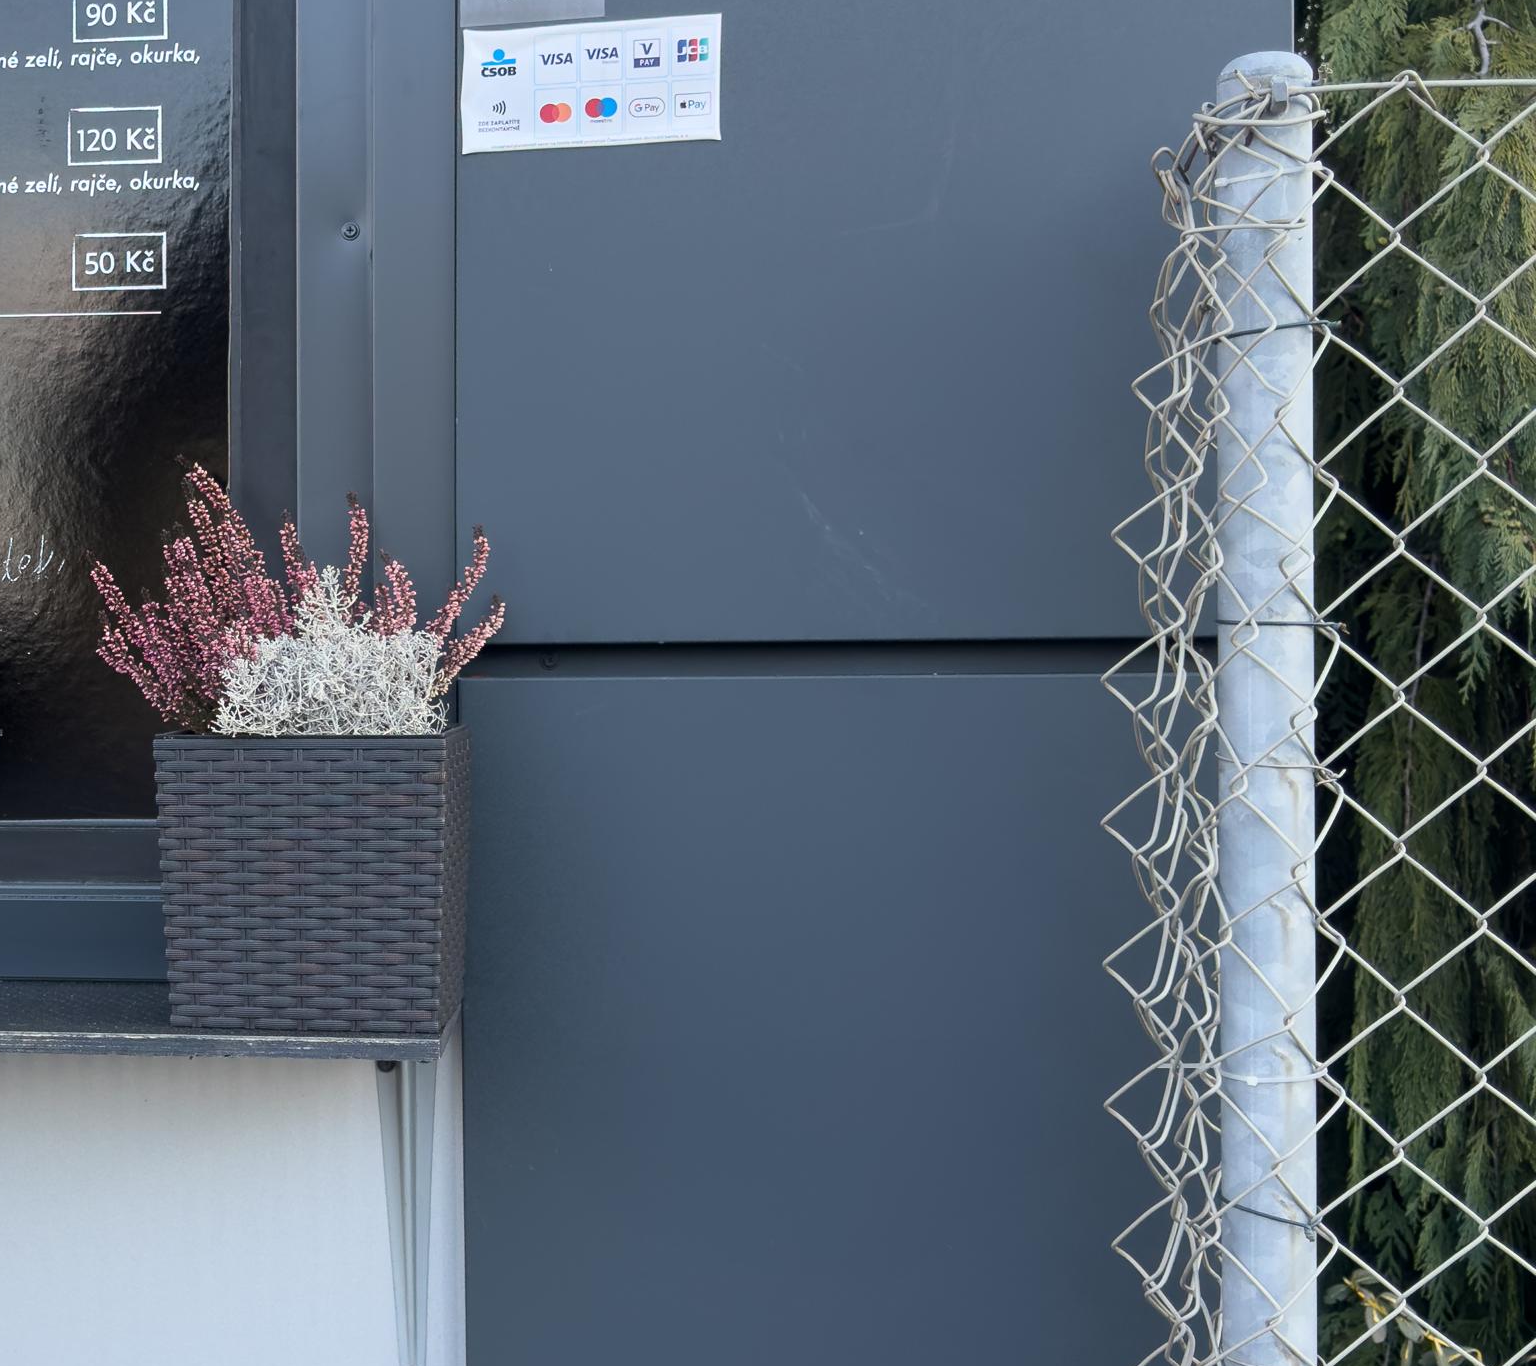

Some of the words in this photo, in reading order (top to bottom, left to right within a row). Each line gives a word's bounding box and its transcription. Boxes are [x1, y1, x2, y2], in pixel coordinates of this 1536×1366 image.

[86, 3, 116, 26] 90
[128, 1, 155, 23] Kč
[25, 48, 62, 69] zelí,
[71, 47, 121, 71] rajče,
[131, 44, 200, 65] okurka,
[538, 53, 573, 65] VISA
[584, 47, 619, 60] VISA
[639, 58, 655, 67] PAY
[645, 103, 660, 113] Pay
[688, 99, 707, 109] Pay
[77, 129, 116, 151] 120
[127, 128, 154, 150] Kč
[25, 174, 62, 195] zelí,
[71, 173, 121, 197] rajče,
[130, 171, 199, 191] okurka,
[85, 252, 114, 274] 50
[127, 250, 154, 272] Kč
